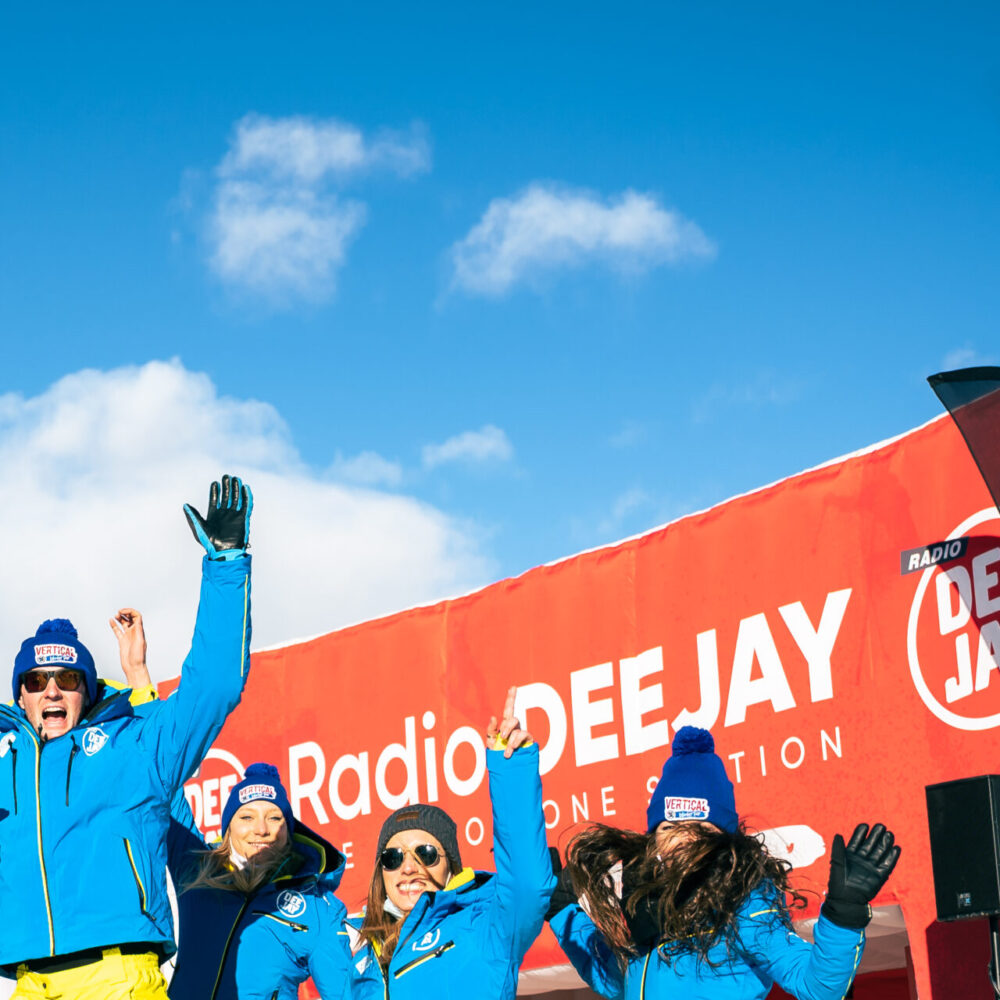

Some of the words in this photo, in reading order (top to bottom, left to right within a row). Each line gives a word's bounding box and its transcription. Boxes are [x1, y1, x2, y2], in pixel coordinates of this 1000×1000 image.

[908, 541, 962, 571] RADIO
[936, 547, 1000, 635] DE
[35, 645, 76, 658] VERTICAL
[945, 619, 1000, 704] JA
[288, 710, 488, 825] Radio
[514, 587, 853, 778] DEEJAY
[665, 798, 708, 812] VERTICAL
